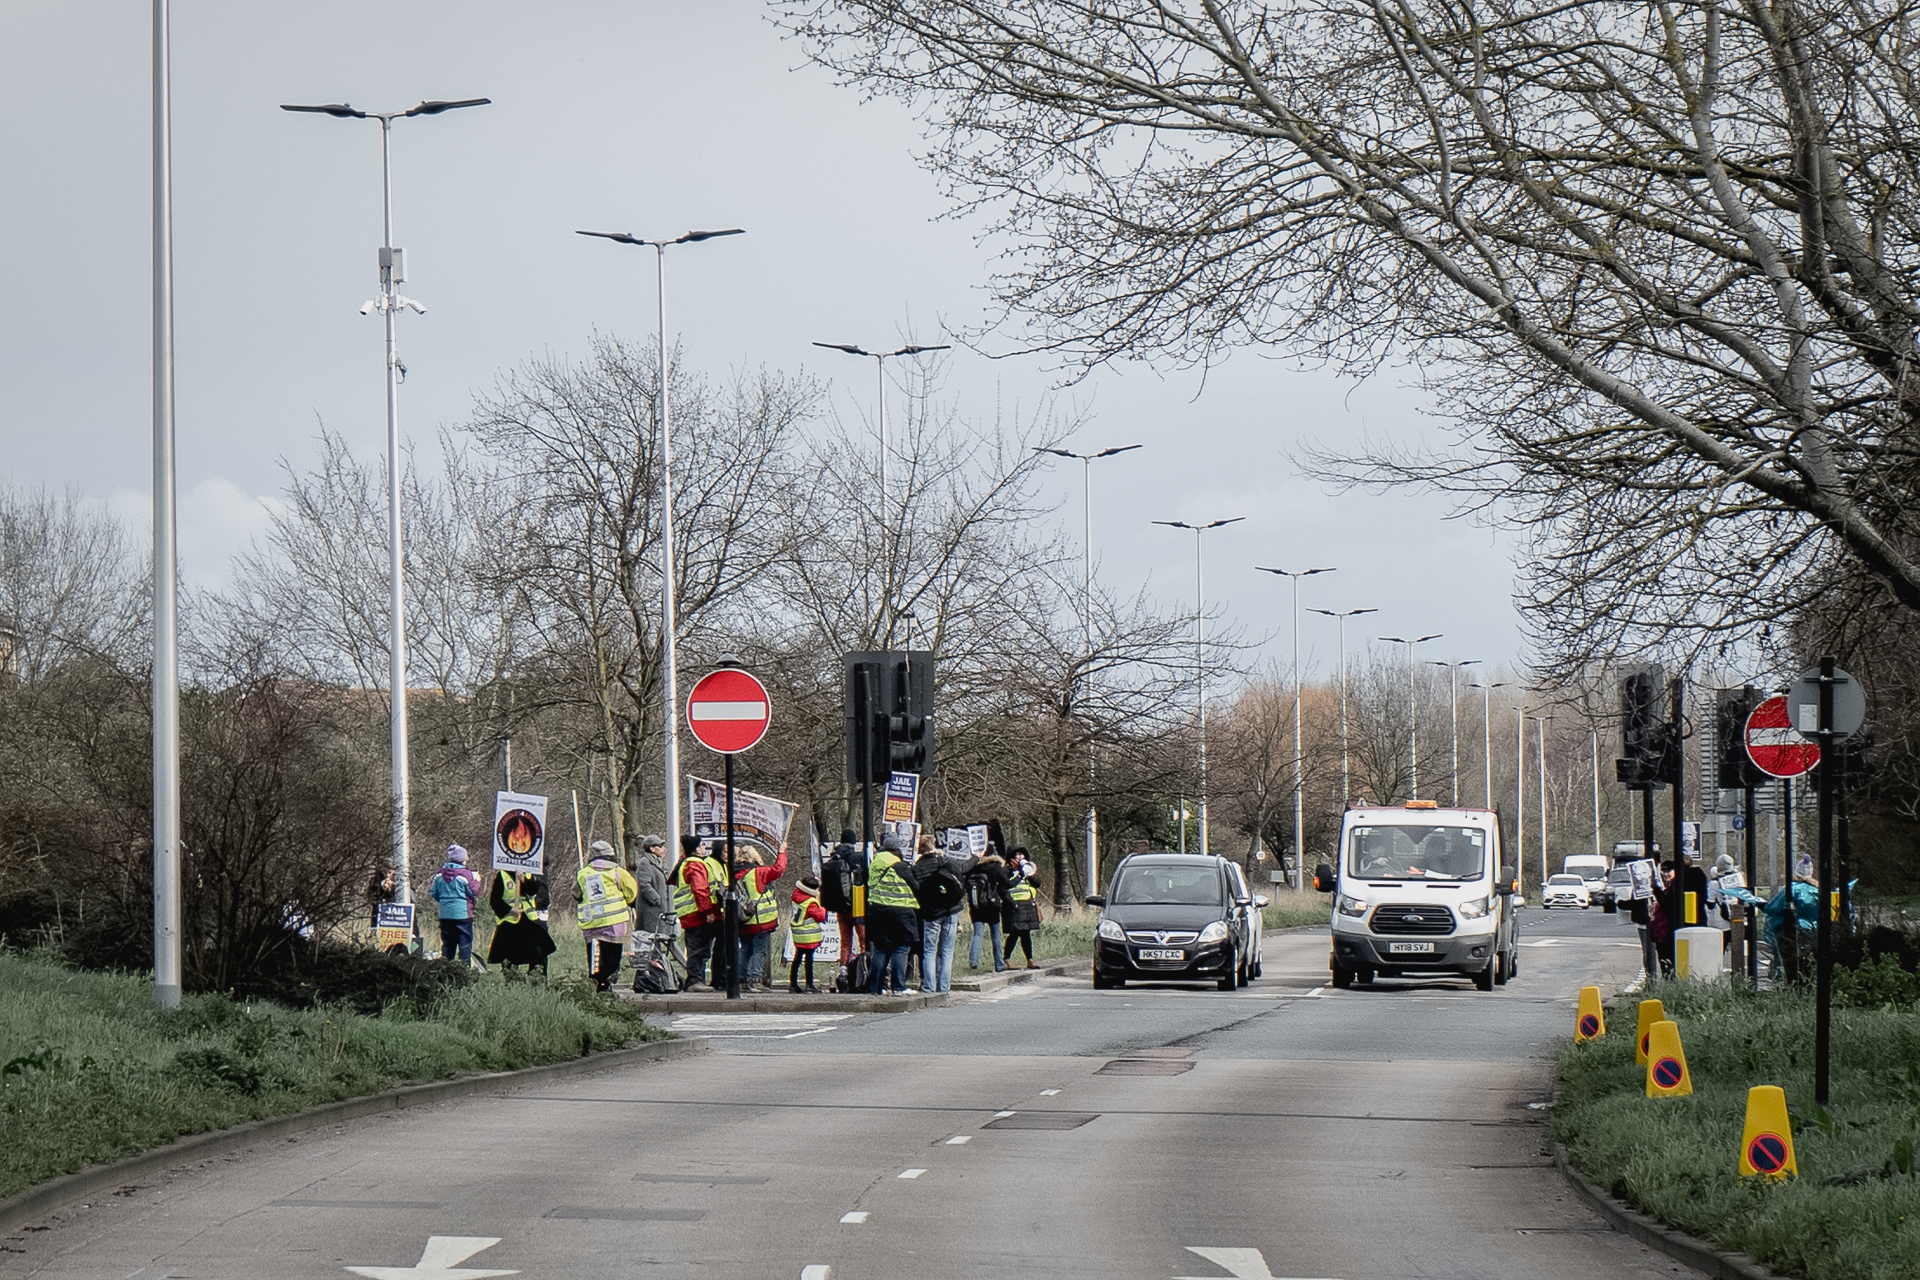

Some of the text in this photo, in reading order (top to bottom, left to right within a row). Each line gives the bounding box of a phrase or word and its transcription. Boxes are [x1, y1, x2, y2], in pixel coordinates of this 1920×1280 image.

[893, 777, 911, 786] JAIL
[887, 800, 912, 811] FREE
[385, 907, 407, 915] JAIL
[380, 930, 408, 939] FREE
